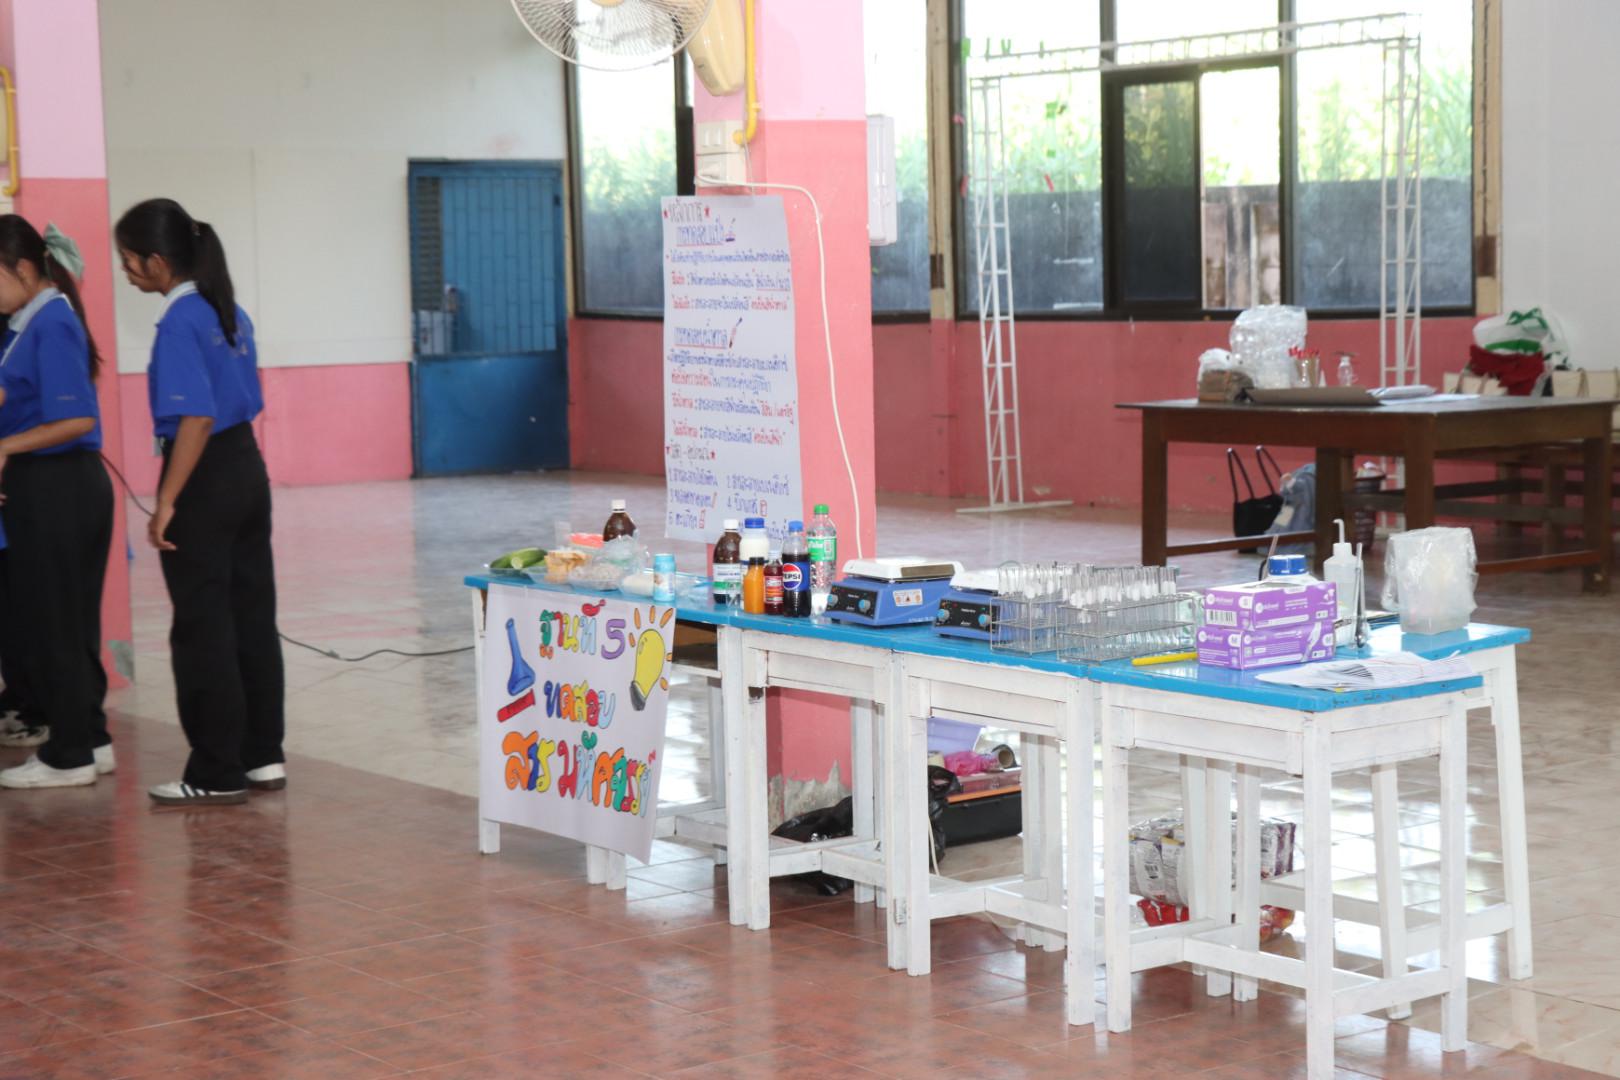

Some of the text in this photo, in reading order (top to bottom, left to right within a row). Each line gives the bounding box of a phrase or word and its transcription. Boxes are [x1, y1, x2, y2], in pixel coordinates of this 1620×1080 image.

[539, 599, 626, 660] ฐานที่ 5
[543, 679, 616, 729] ทดสอบ
